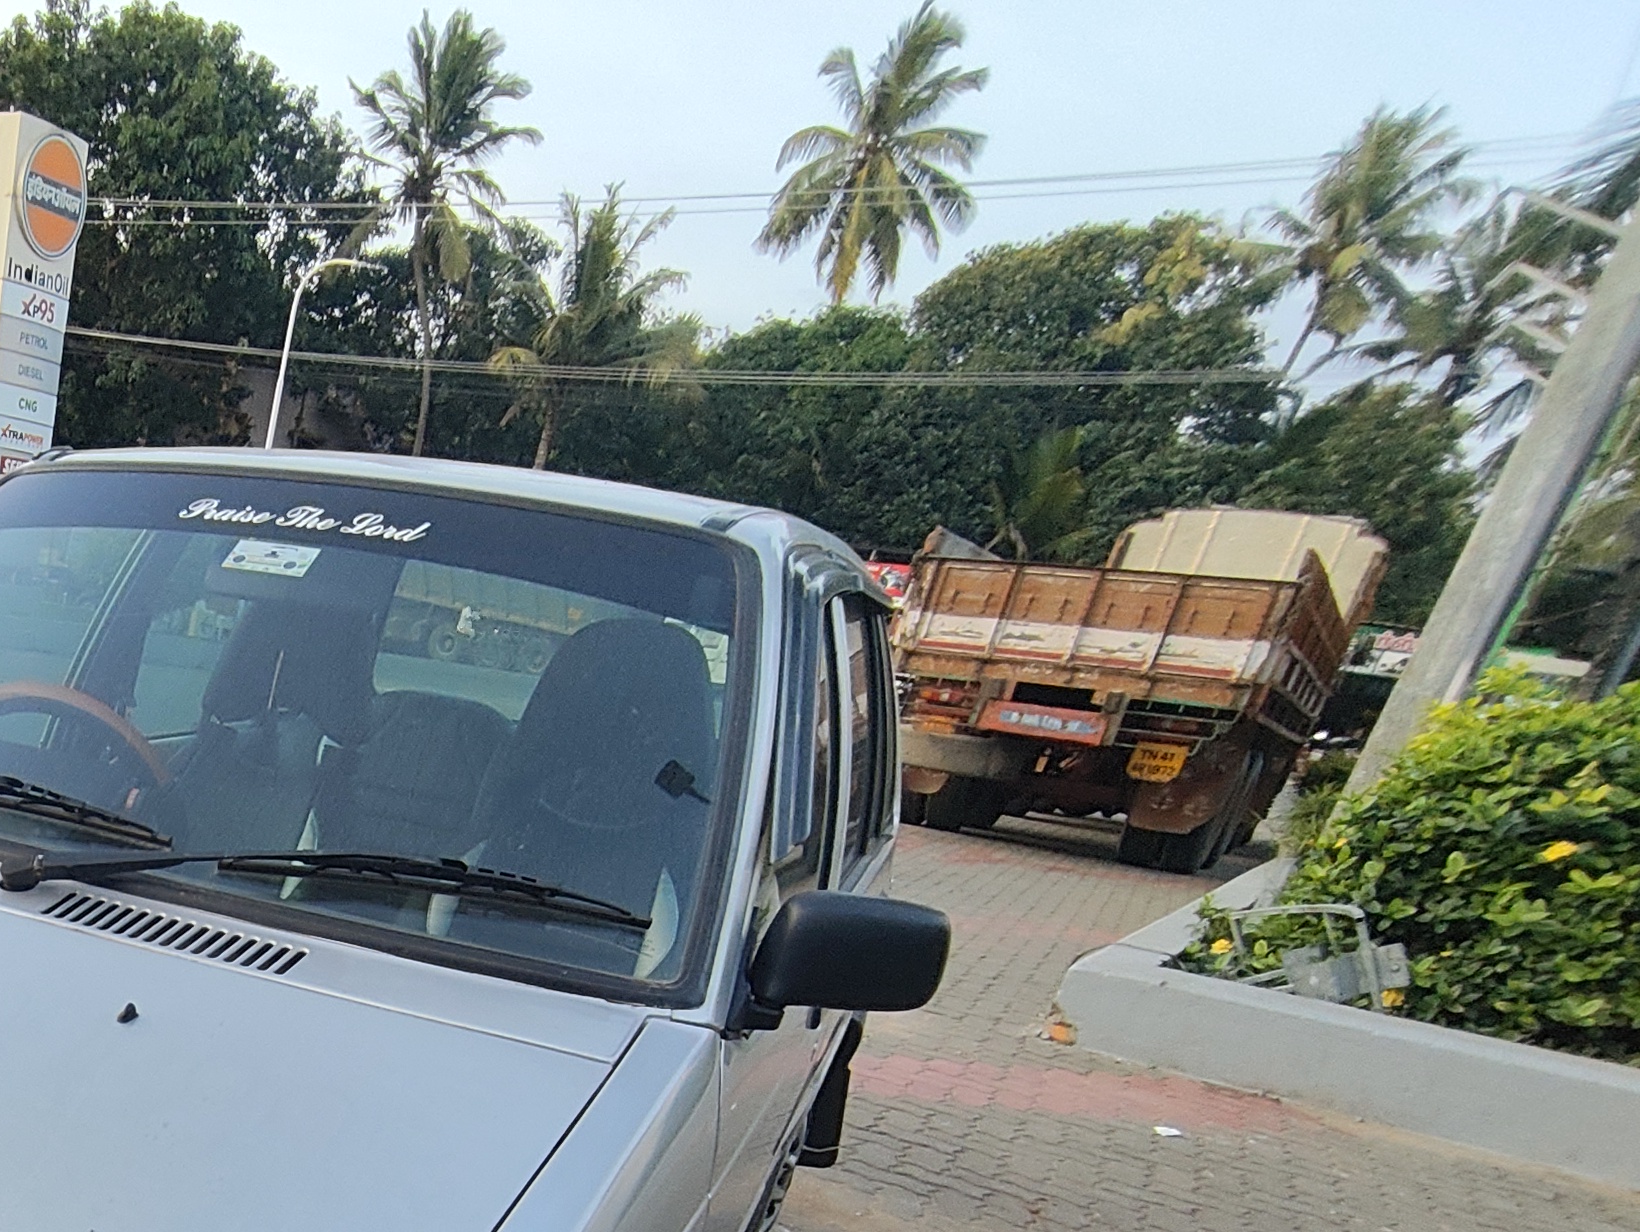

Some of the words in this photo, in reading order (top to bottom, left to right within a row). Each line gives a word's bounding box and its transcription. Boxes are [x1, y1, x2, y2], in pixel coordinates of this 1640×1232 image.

[8, 257, 69, 297] IndianOil
[20, 331, 49, 350] PETROL
[18, 364, 44, 381] DIESEL
[18, 397, 38, 413] CNG
[179, 498, 276, 524] Praise
[275, 505, 343, 531] The
[340, 512, 432, 542] Lord
